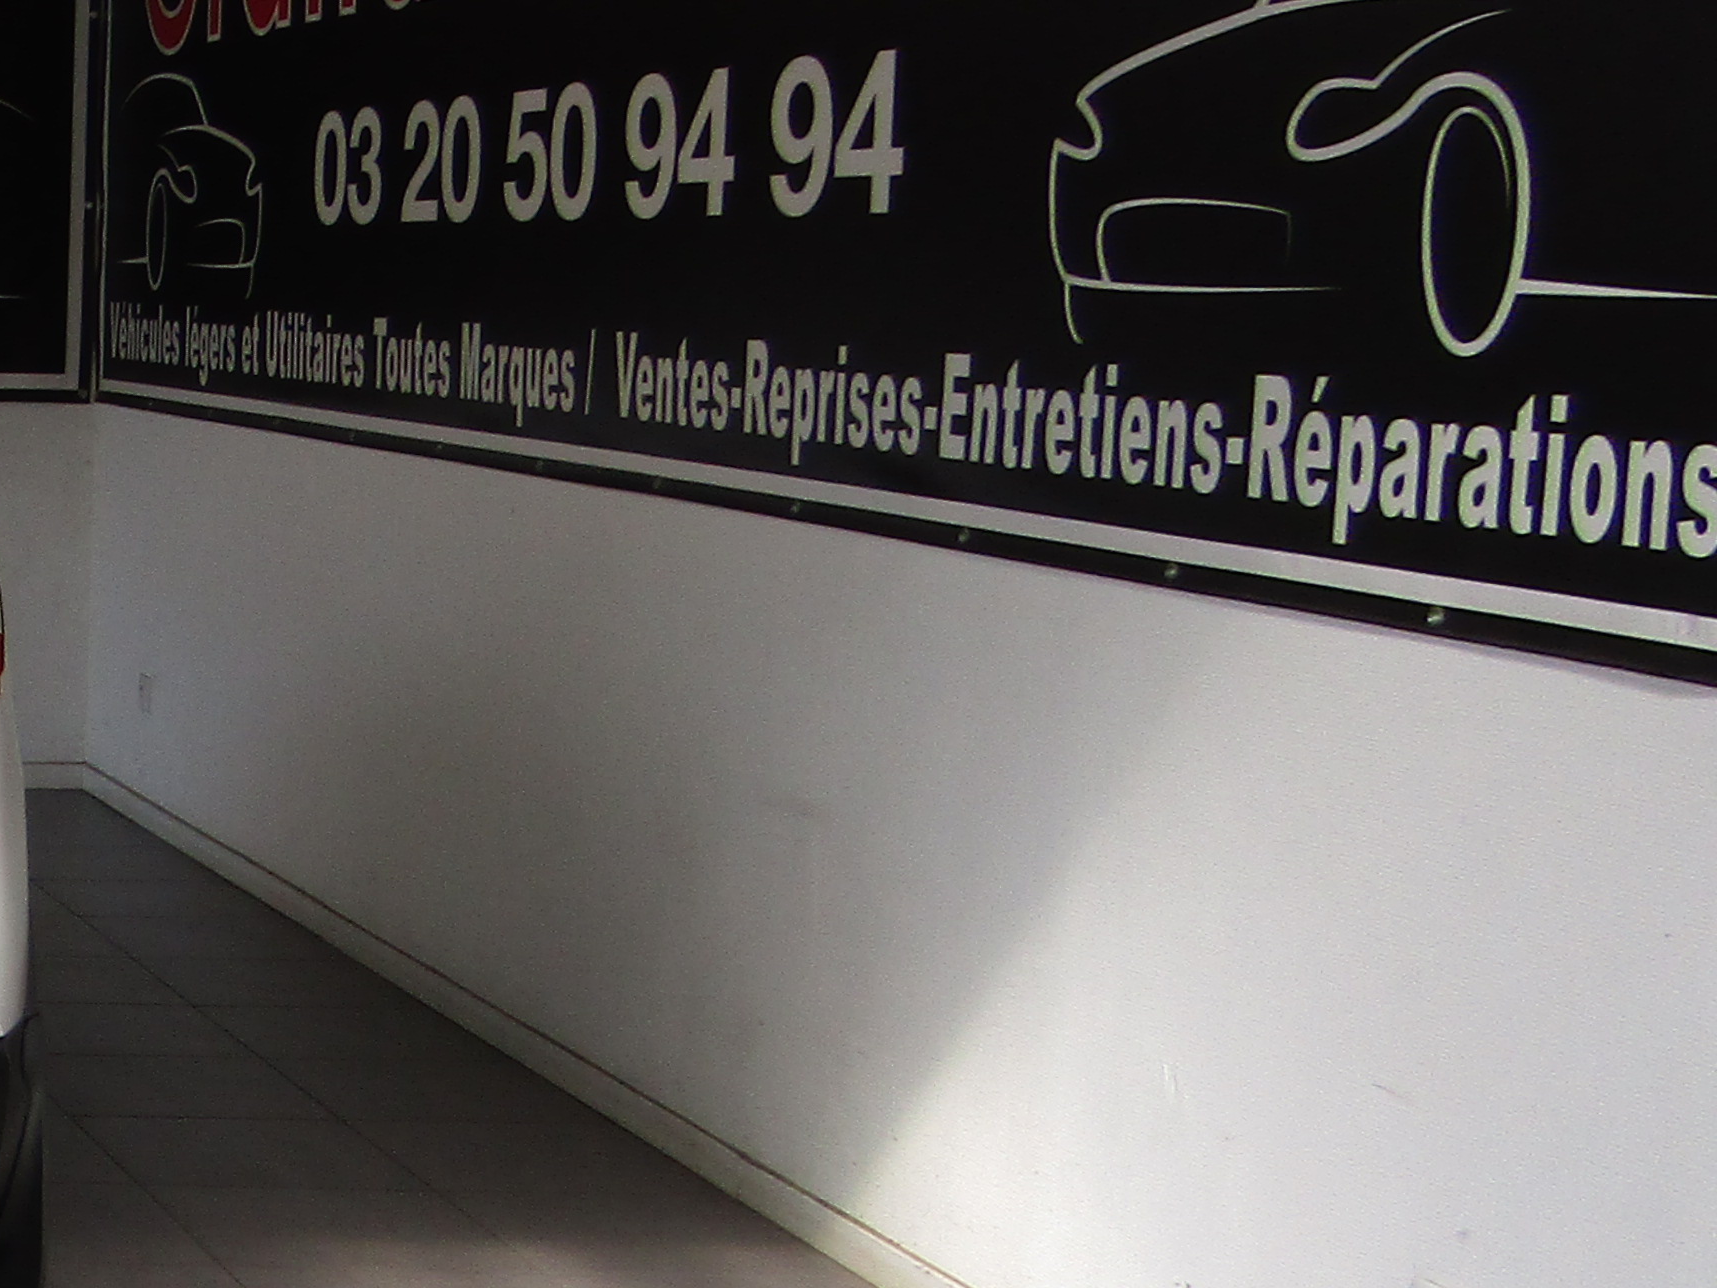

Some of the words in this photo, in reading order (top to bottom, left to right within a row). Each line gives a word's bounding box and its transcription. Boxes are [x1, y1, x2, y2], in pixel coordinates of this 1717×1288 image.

[314, 106, 382, 225] 03
[400, 95, 481, 224] 20
[503, 81, 597, 222] 50
[624, 67, 735, 220] 94
[768, 49, 905, 218] 94
[110, 302, 180, 366] Véhicules
[185, 305, 236, 386] légers
[241, 313, 259, 375] et
[266, 309, 365, 388] Utilitaires
[373, 317, 451, 399] Toutes
[460, 322, 575, 427] Marques
